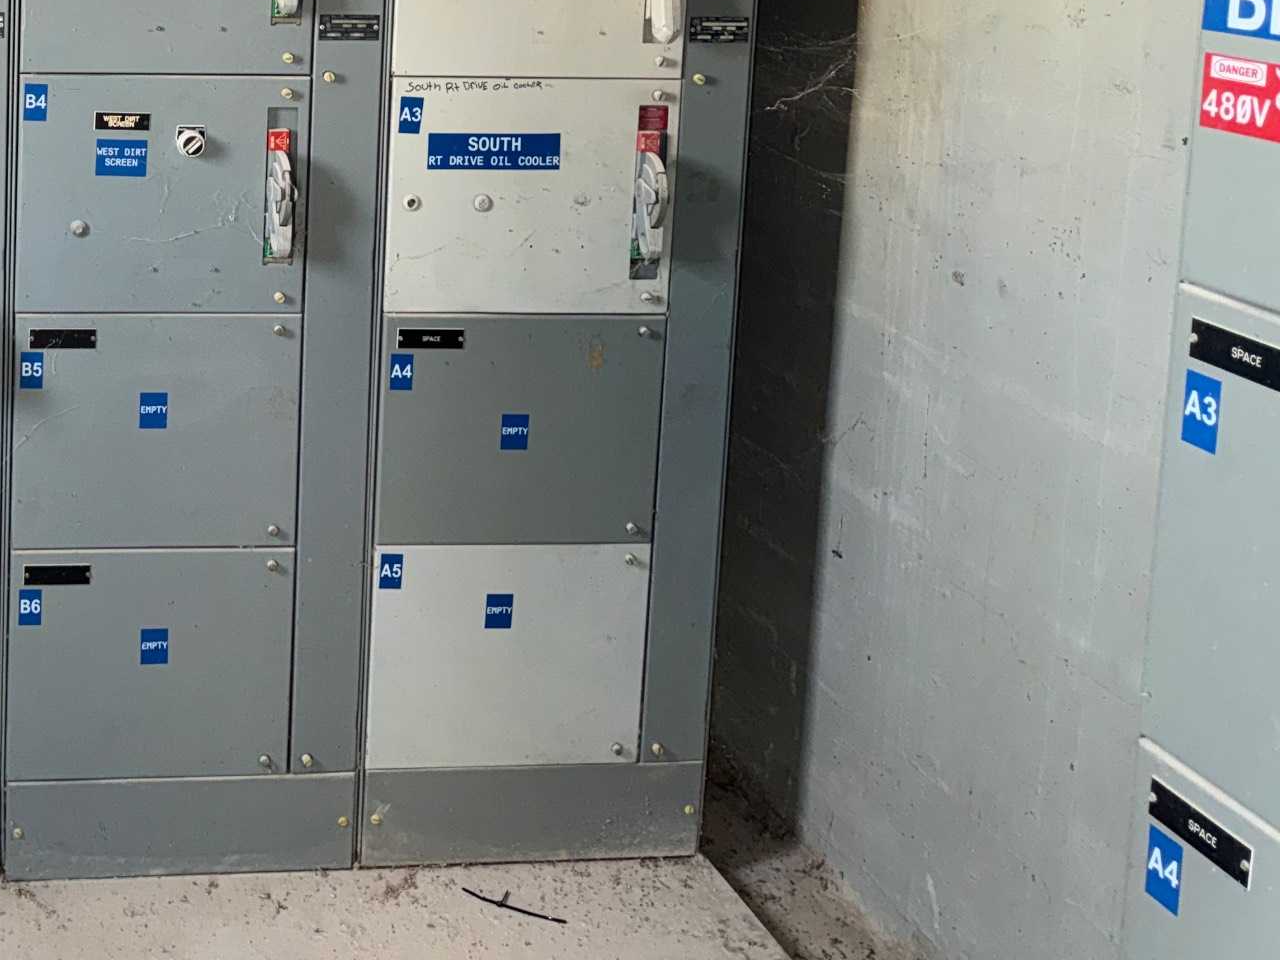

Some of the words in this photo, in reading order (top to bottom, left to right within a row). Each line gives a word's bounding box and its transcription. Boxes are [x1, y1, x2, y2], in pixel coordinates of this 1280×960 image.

[1219, 63, 1258, 78] DANGER
[25, 95, 46, 109] B4
[400, 107, 422, 122] A3
[97, 147, 121, 156] WEST
[125, 147, 147, 156] DIRT
[468, 137, 521, 152] SOUTH
[104, 158, 138, 167] SCREEN
[429, 156, 442, 165] RT
[449, 156, 483, 165] DRIVE
[491, 156, 511, 165] OIL
[518, 156, 560, 166] COOLER
[1232, 347, 1262, 368] SPACE
[22, 363, 42, 377] B5
[391, 364, 412, 378] A4
[140, 406, 167, 414] EMPTY
[1185, 390, 1217, 426] A3
[502, 427, 528, 435] EMPTY
[381, 564, 401, 577] A5
[21, 599, 41, 614] B6
[141, 642, 167, 650] EMPTY
[1188, 819, 1218, 849] SPACE
[1148, 846, 1179, 888] A4
